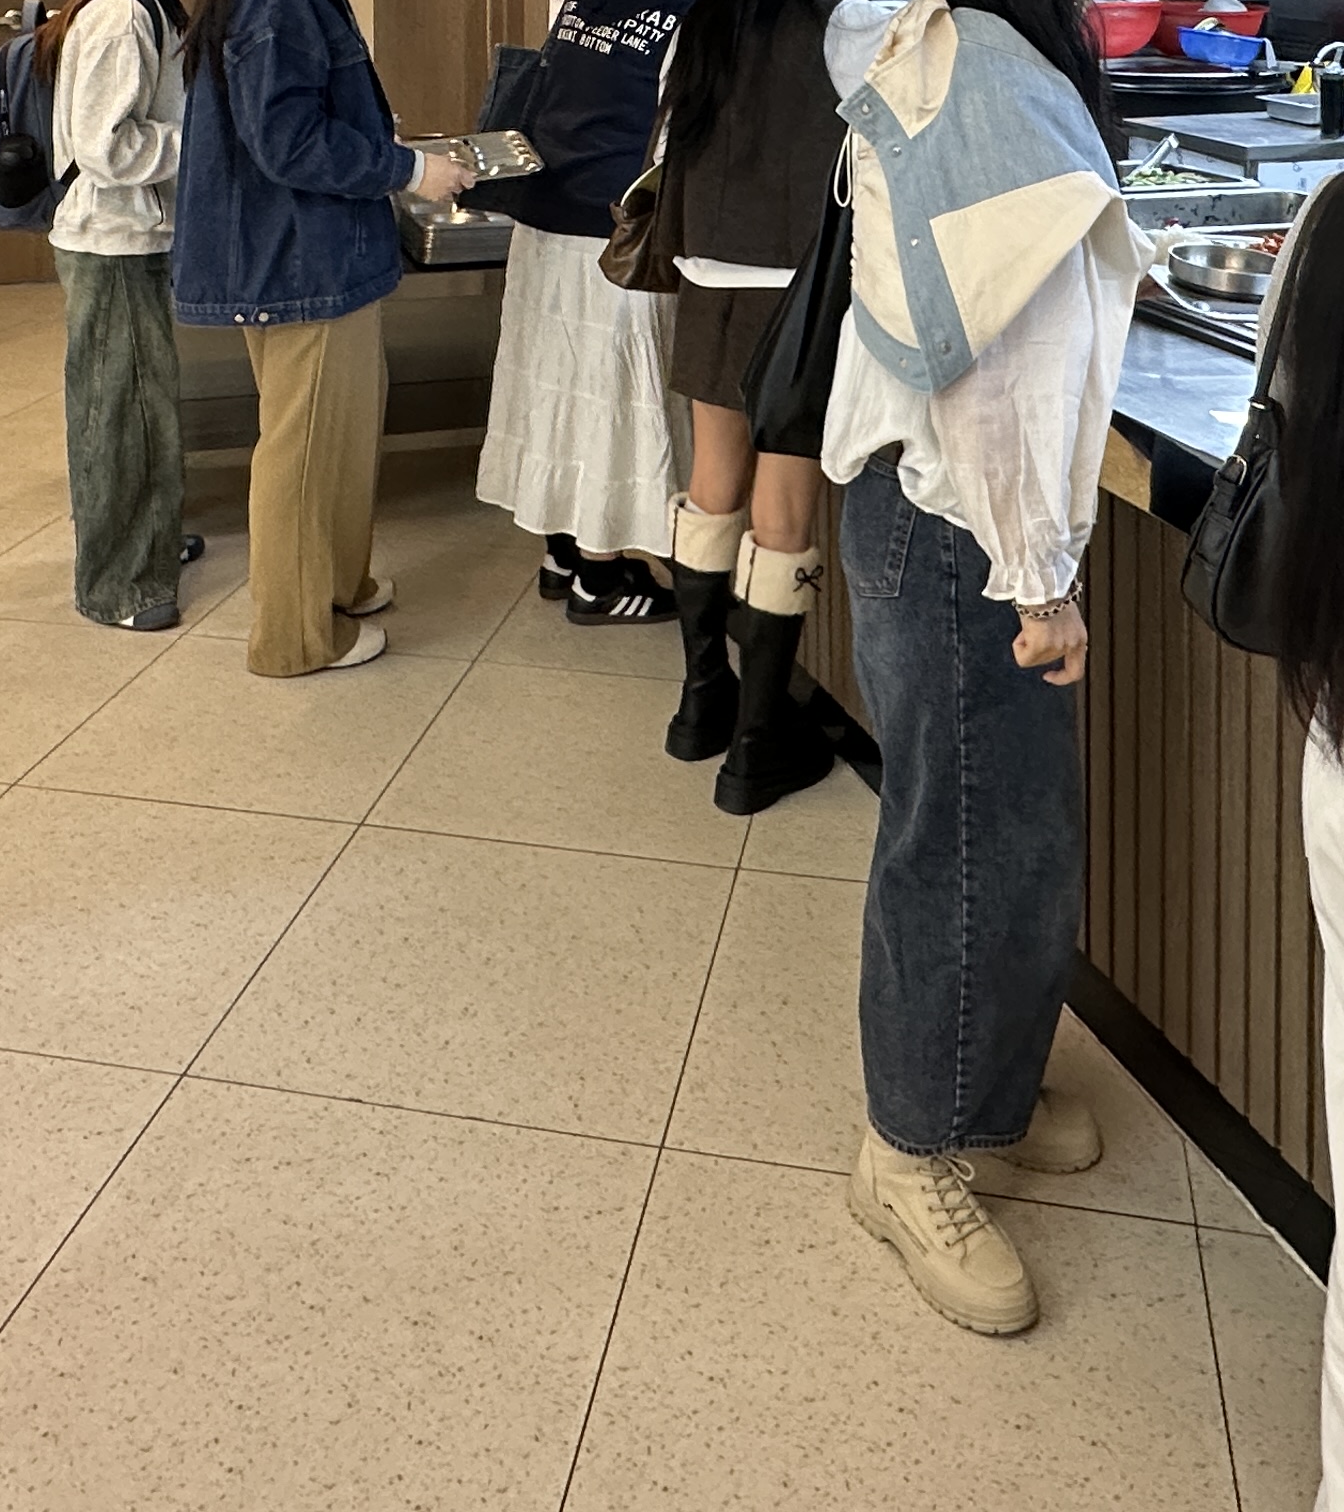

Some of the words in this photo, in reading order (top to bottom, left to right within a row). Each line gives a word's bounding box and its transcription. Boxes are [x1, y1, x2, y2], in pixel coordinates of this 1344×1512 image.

[623, 18, 665, 42] PATTY
[636, 9, 677, 31] AB
[579, 34, 613, 55] BOTTOM
[621, 33, 650, 55] LANE,
